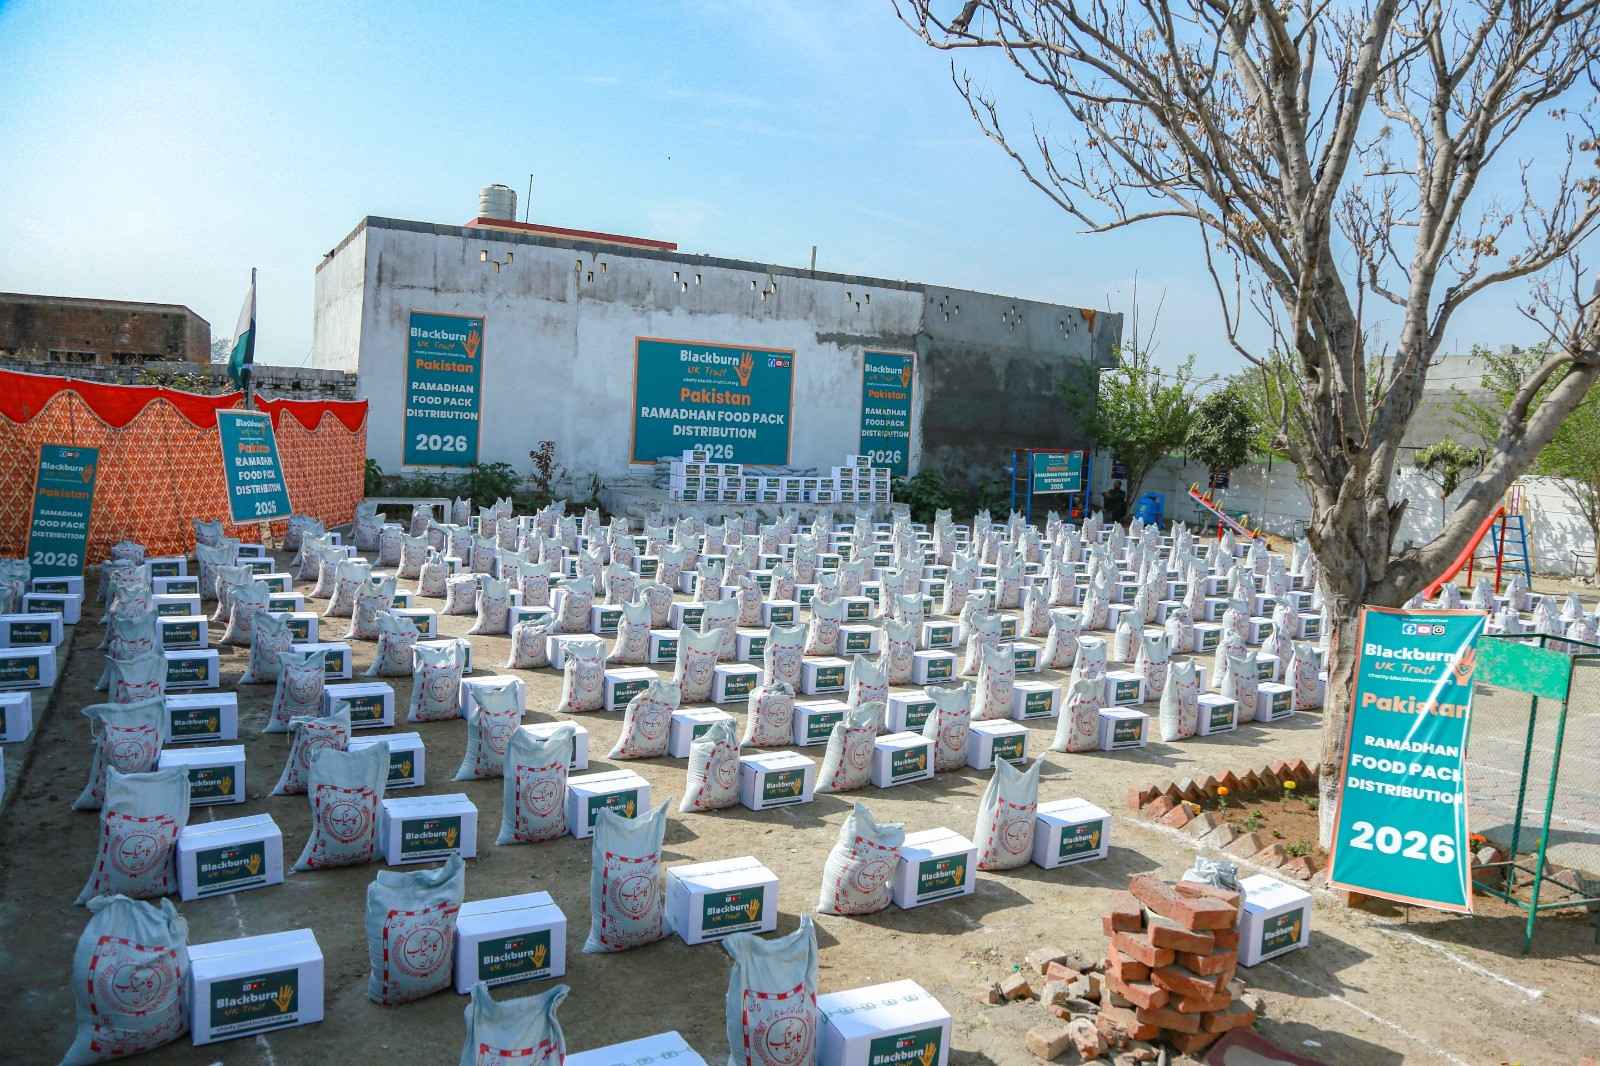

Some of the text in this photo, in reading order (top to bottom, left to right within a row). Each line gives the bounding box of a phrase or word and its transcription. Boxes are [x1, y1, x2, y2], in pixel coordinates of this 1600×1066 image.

[410, 327, 467, 341] Blackburn
[680, 350, 739, 366] Blackburn
[415, 359, 473, 373] Pakistan
[687, 366, 700, 374] UK
[864, 363, 902, 375] Blackburn
[412, 381, 474, 393] RAMADHAN
[412, 395, 472, 407] FOOD PACK
[680, 387, 751, 406] Pakistan
[406, 408, 478, 420] DISTRIBUTION
[641, 406, 784, 425] RAMADHAN FOOD PACK
[865, 407, 907, 417] RAMADHAN
[865, 418, 905, 427] FOOD PACK
[672, 425, 757, 439] DISTRIBUTION
[861, 430, 909, 438] DISTRIBUTION
[415, 433, 468, 452] 2026
[867, 449, 902, 464] 2026
[40, 461, 84, 473] Blackburn
[239, 471, 262, 481] FOOD
[40, 488, 89, 500] Pakistan
[40, 508, 83, 519] RAMADHAN
[33, 519, 86, 530] FOOD PACK
[31, 530, 86, 541] DISTRIBUTION
[32, 551, 79, 568] 2026
[1365, 642, 1457, 664] Blackburn
[1375, 661, 1436, 675] UK Trust
[1364, 735, 1459, 758] RAMADHAN
[1351, 753, 1407, 775] FOOD
[405, 831, 448, 840] Blackburn
[1349, 819, 1457, 865] 2026
[200, 858, 250, 873] Blackburn
[921, 869, 956, 881] Blackburn
[706, 903, 750, 916] Blackburn
[483, 950, 535, 965] Blackburn
[216, 991, 279, 1009] Blackburn
[873, 1048, 924, 1065] Blackburn
